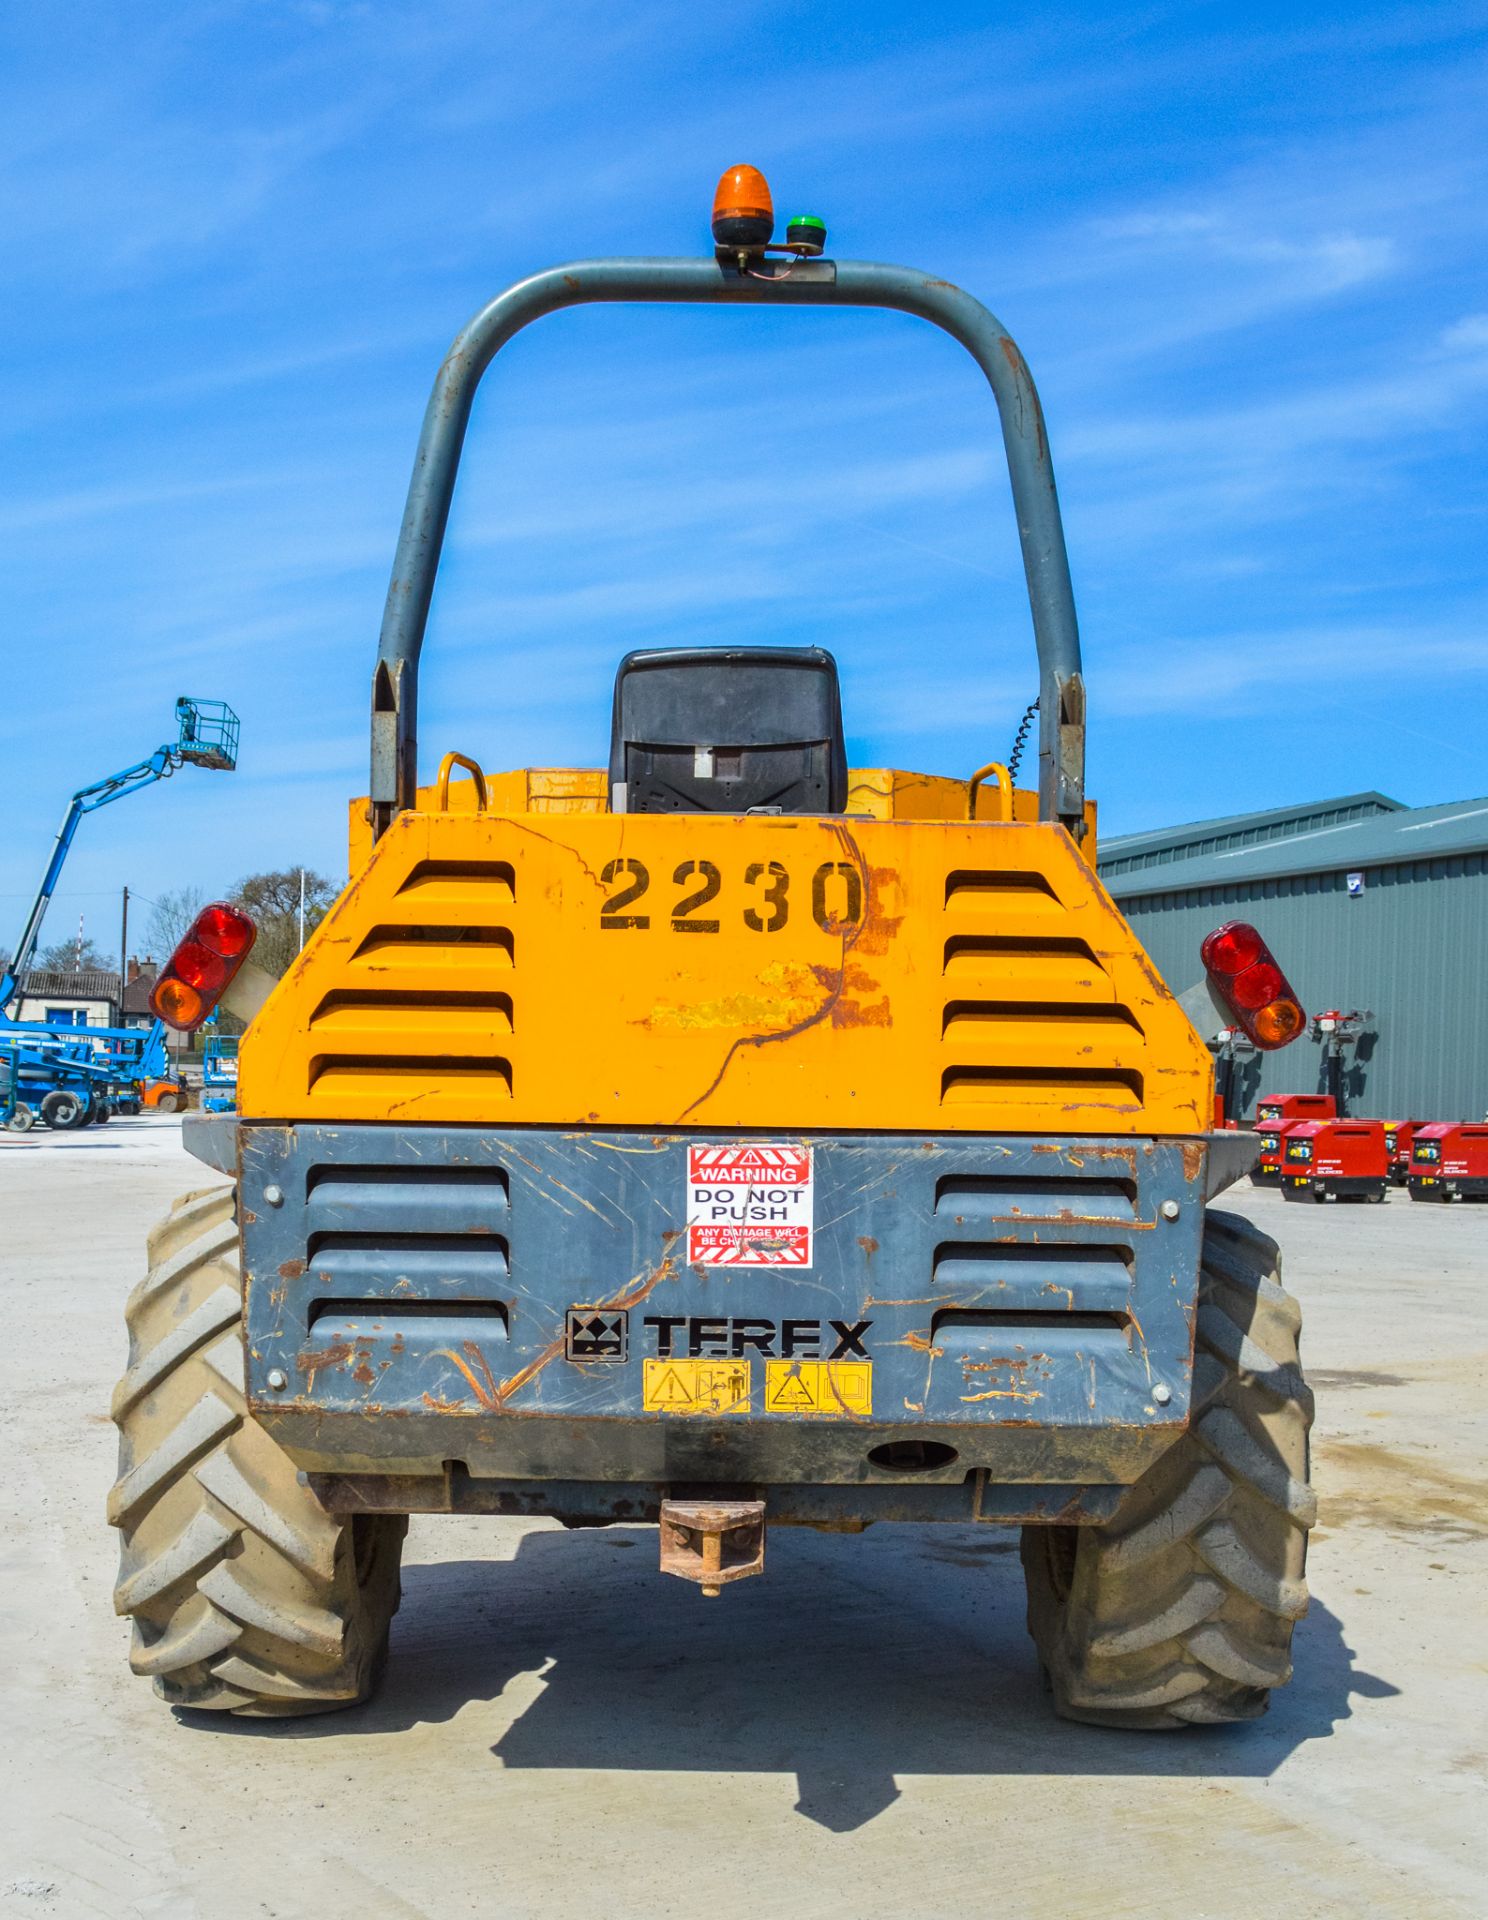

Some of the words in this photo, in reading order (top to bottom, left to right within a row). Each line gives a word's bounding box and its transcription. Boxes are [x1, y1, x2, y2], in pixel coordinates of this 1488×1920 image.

[600, 858, 862, 934] 2230
[700, 1168, 797, 1182] WARNING
[694, 1189, 735, 1204] DO
[748, 1189, 805, 1204] NOT
[711, 1207, 787, 1220] PUSH
[697, 1228, 720, 1237] ANY
[723, 1228, 772, 1238] DAMAGE
[776, 1229, 802, 1237] WILL
[701, 1238, 717, 1246] BE
[643, 1316, 874, 1358] TEREX
